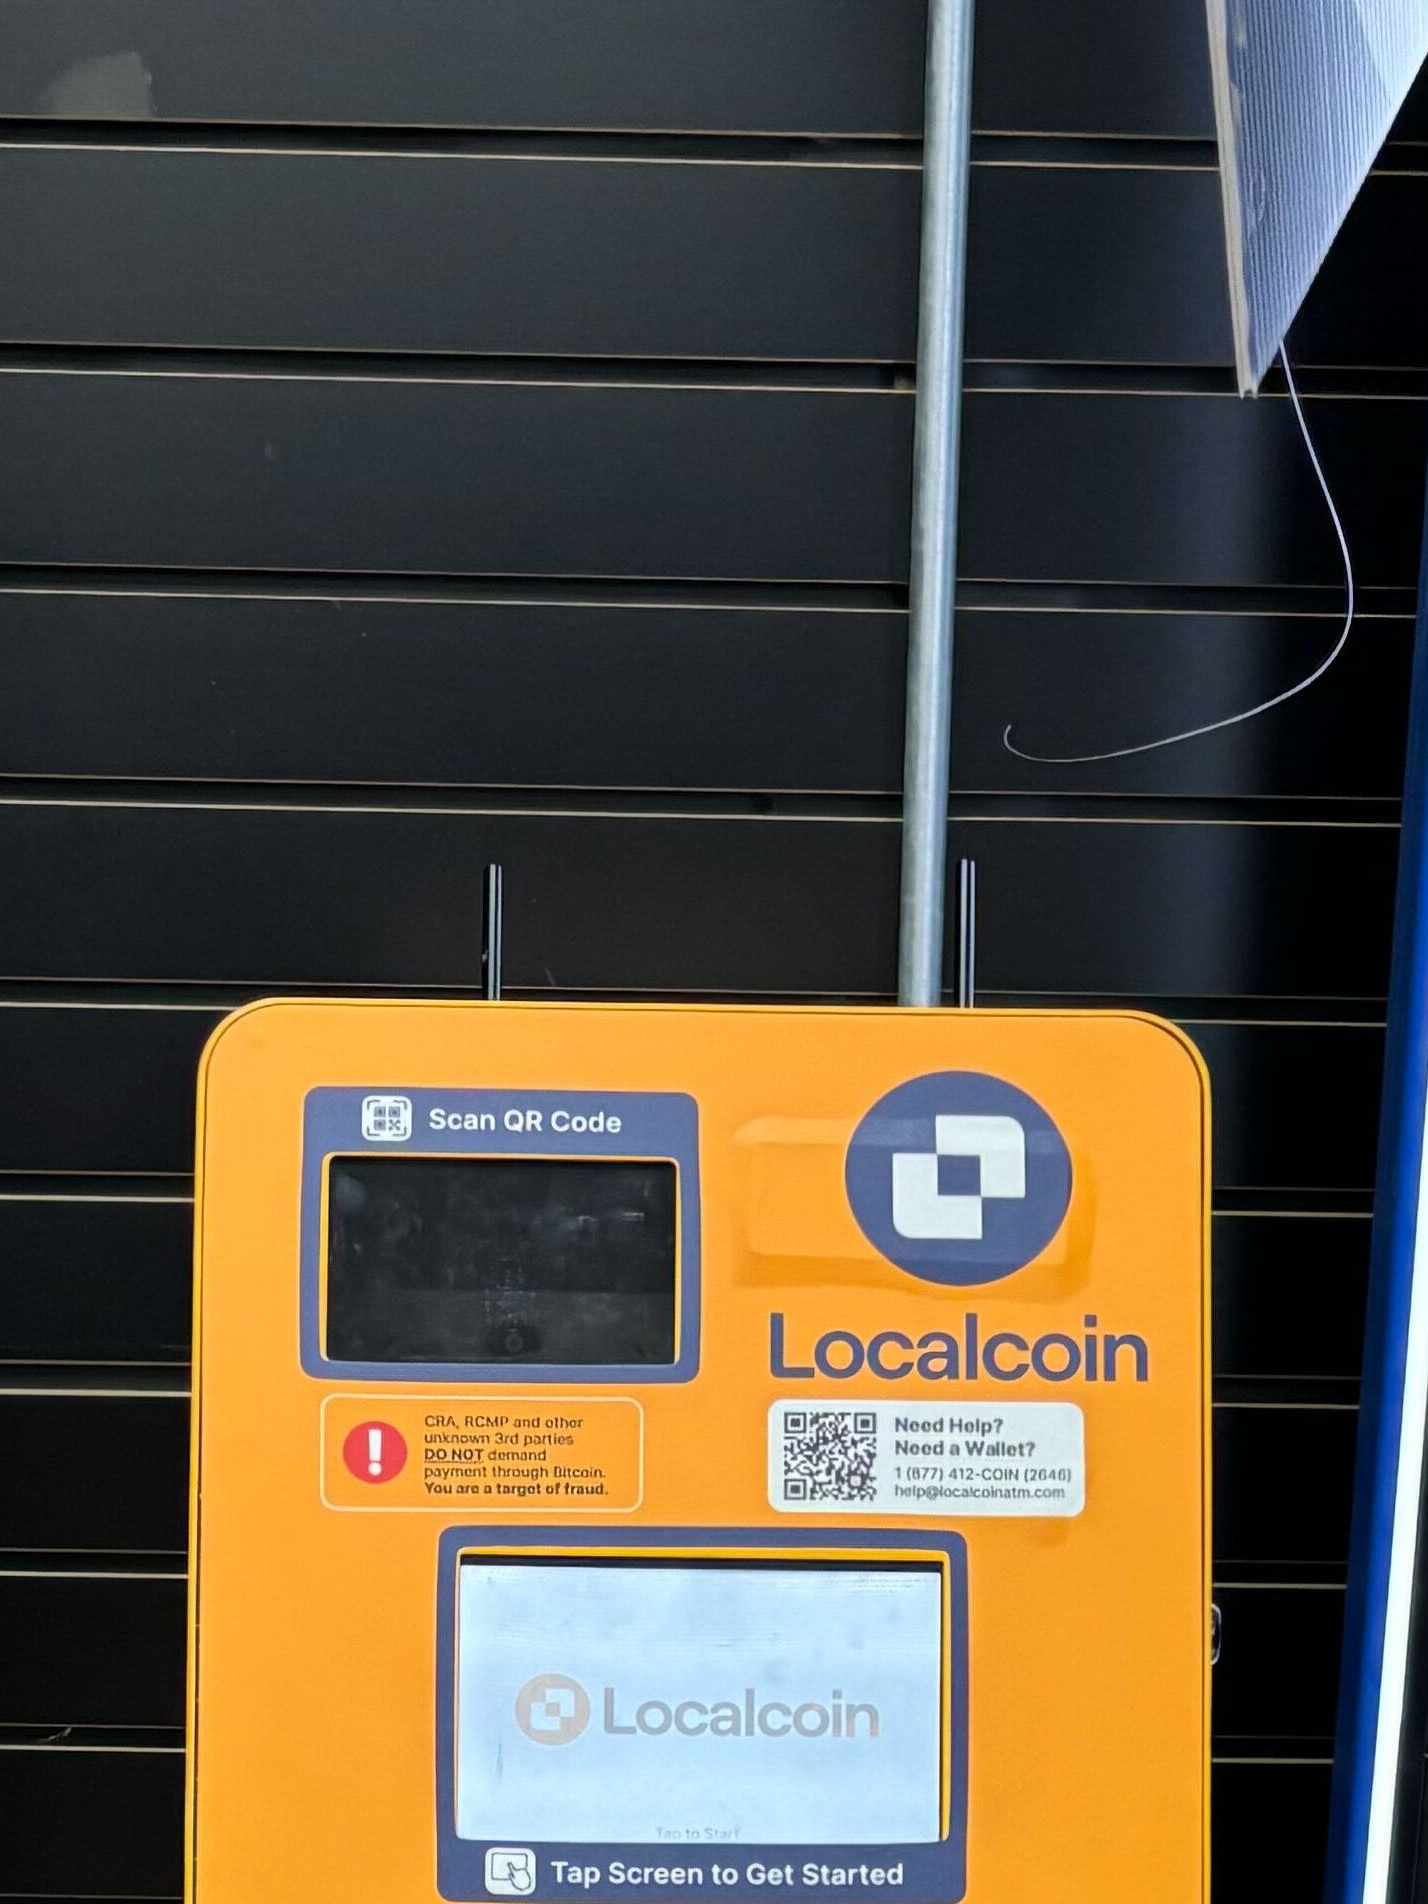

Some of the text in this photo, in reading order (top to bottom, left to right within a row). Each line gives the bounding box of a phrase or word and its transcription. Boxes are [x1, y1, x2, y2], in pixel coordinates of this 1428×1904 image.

[429, 1109, 622, 1135] Scan QR Code
[769, 1311, 1149, 1383] Localcoin
[424, 1415, 583, 1429] CRA, RCMP and other
[895, 1417, 1003, 1437] Need Help?
[424, 1432, 574, 1448] unknown 3rd parties
[424, 1449, 547, 1462] DO NOT demand
[895, 1440, 1036, 1457] Need a Wallet?
[424, 1466, 606, 1482] payment through Bitcoin.
[895, 1467, 902, 1479] 1
[948, 1467, 1020, 1482] 412-COIN
[424, 1482, 609, 1497] You are a target of fraud.
[604, 1687, 880, 1739] Localcoin
[685, 1828, 700, 1839] to
[704, 1827, 740, 1840] Start
[551, 1861, 905, 1888] Tap Screen to Get Started
